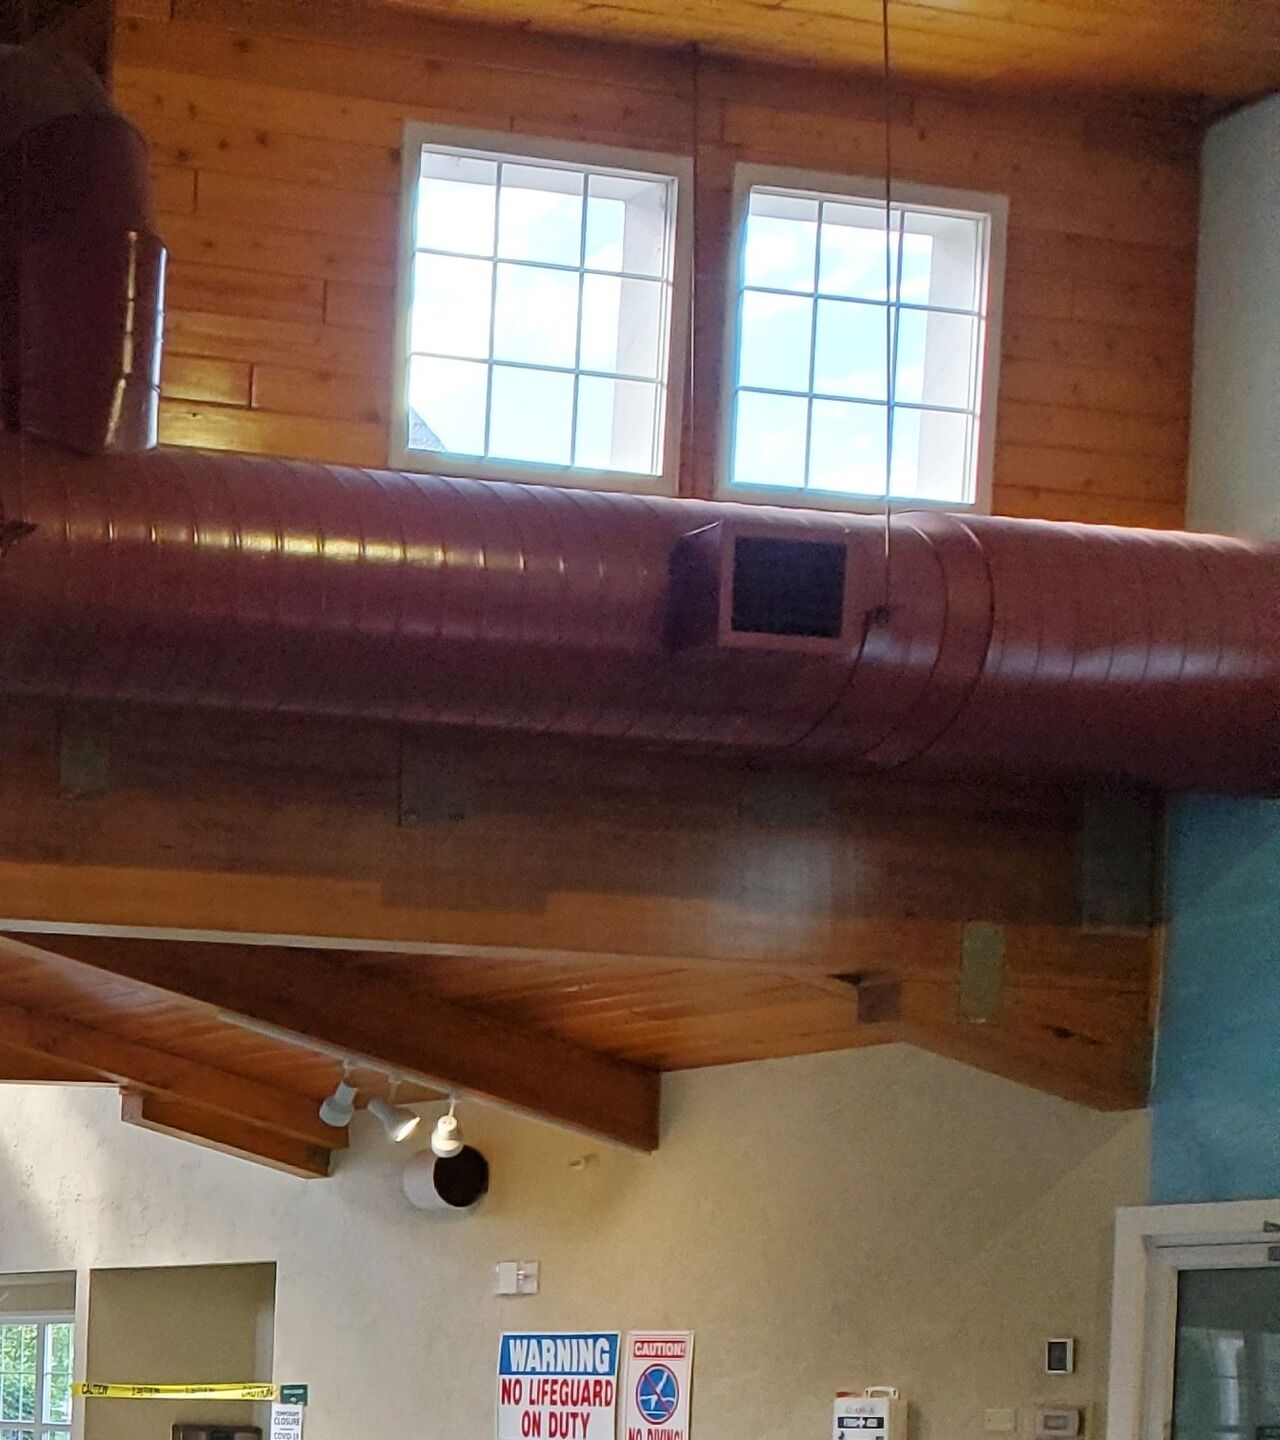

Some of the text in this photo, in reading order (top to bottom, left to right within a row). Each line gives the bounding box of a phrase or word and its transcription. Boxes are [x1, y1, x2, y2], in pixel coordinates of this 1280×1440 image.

[508, 1338, 610, 1374] WARNING
[635, 1342, 685, 1356] CAUTION!
[501, 1378, 613, 1408] NO LIFEGUARD
[273, 1417, 301, 1426] CLOSURE
[521, 1410, 590, 1440] ON DUTY
